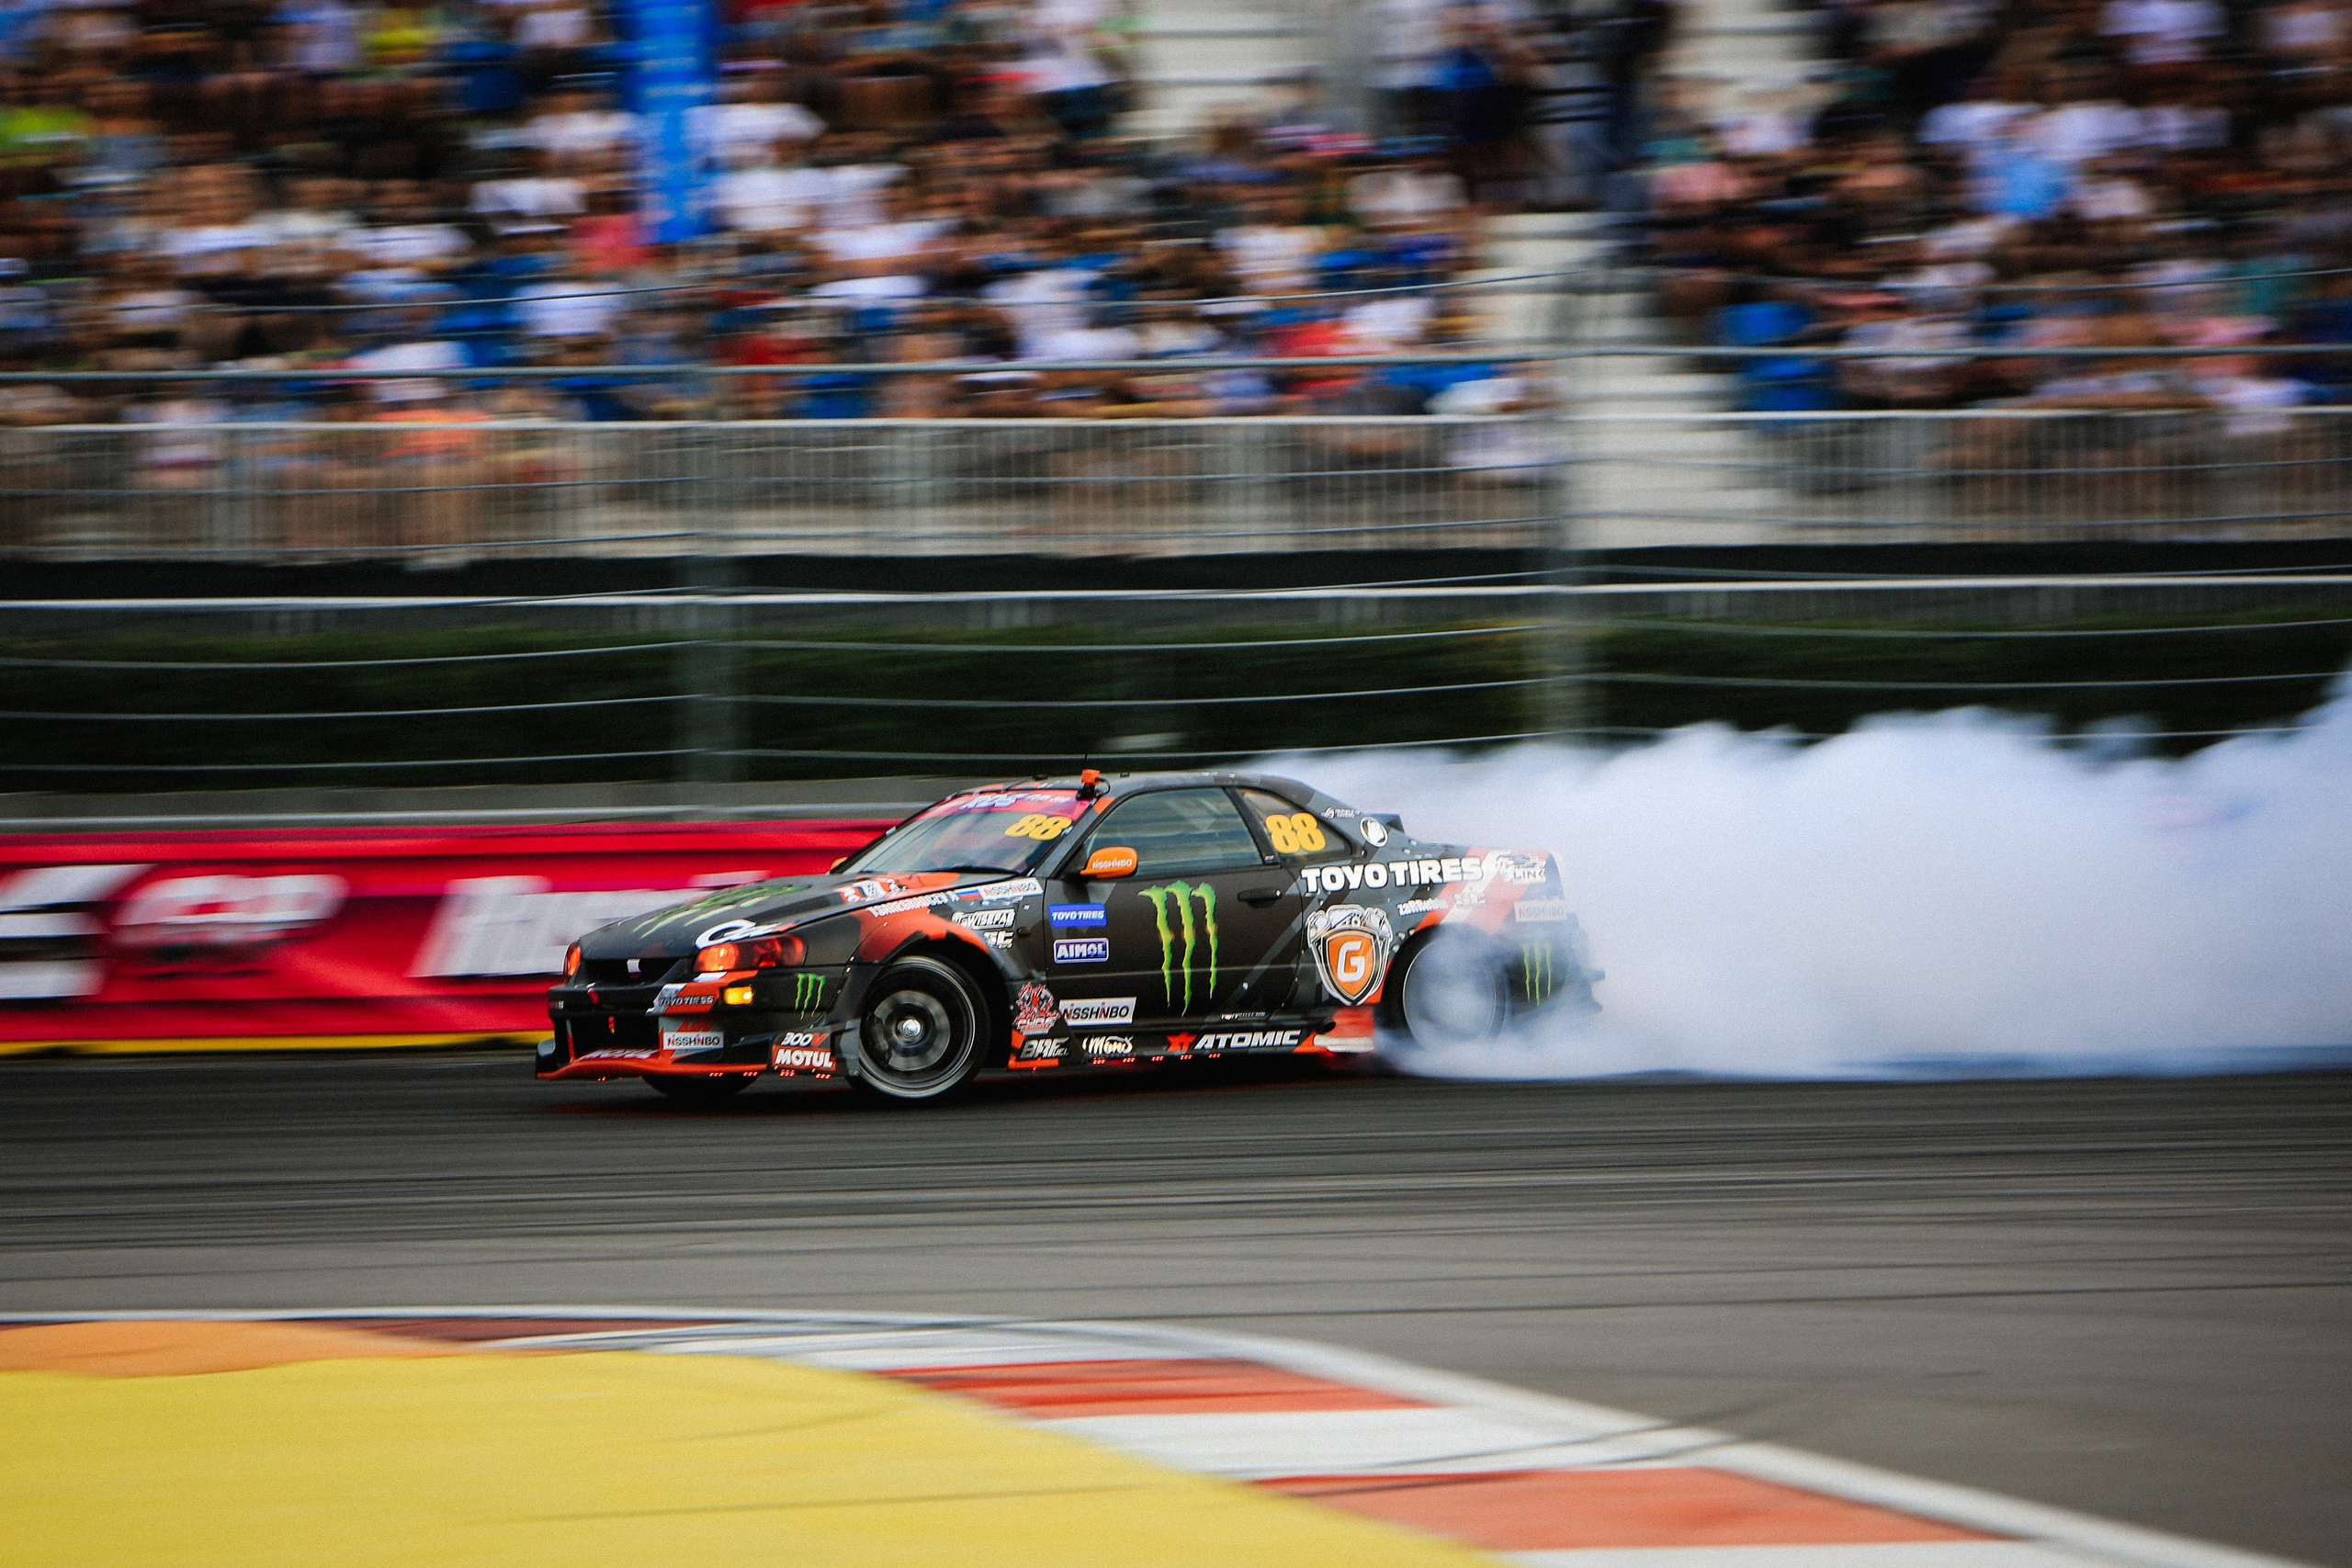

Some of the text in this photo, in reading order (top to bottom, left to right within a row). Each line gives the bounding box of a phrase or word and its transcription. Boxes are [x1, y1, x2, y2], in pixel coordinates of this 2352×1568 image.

[1004, 814, 1072, 840] 88
[1265, 812, 1327, 854] 88
[1301, 863, 1388, 893] TOYO
[1388, 856, 1484, 887] TIRES
[1052, 909, 1104, 921] TOYO TIRES
[1337, 941, 1366, 982] G
[659, 997, 683, 1007] TOYO
[1063, 1002, 1130, 1021] NISSHINBO
[668, 1033, 720, 1047] NISSHINBO
[781, 1032, 830, 1047] 300V
[1194, 1030, 1301, 1050] ATOMIC
[775, 1048, 833, 1068] MOTUL
